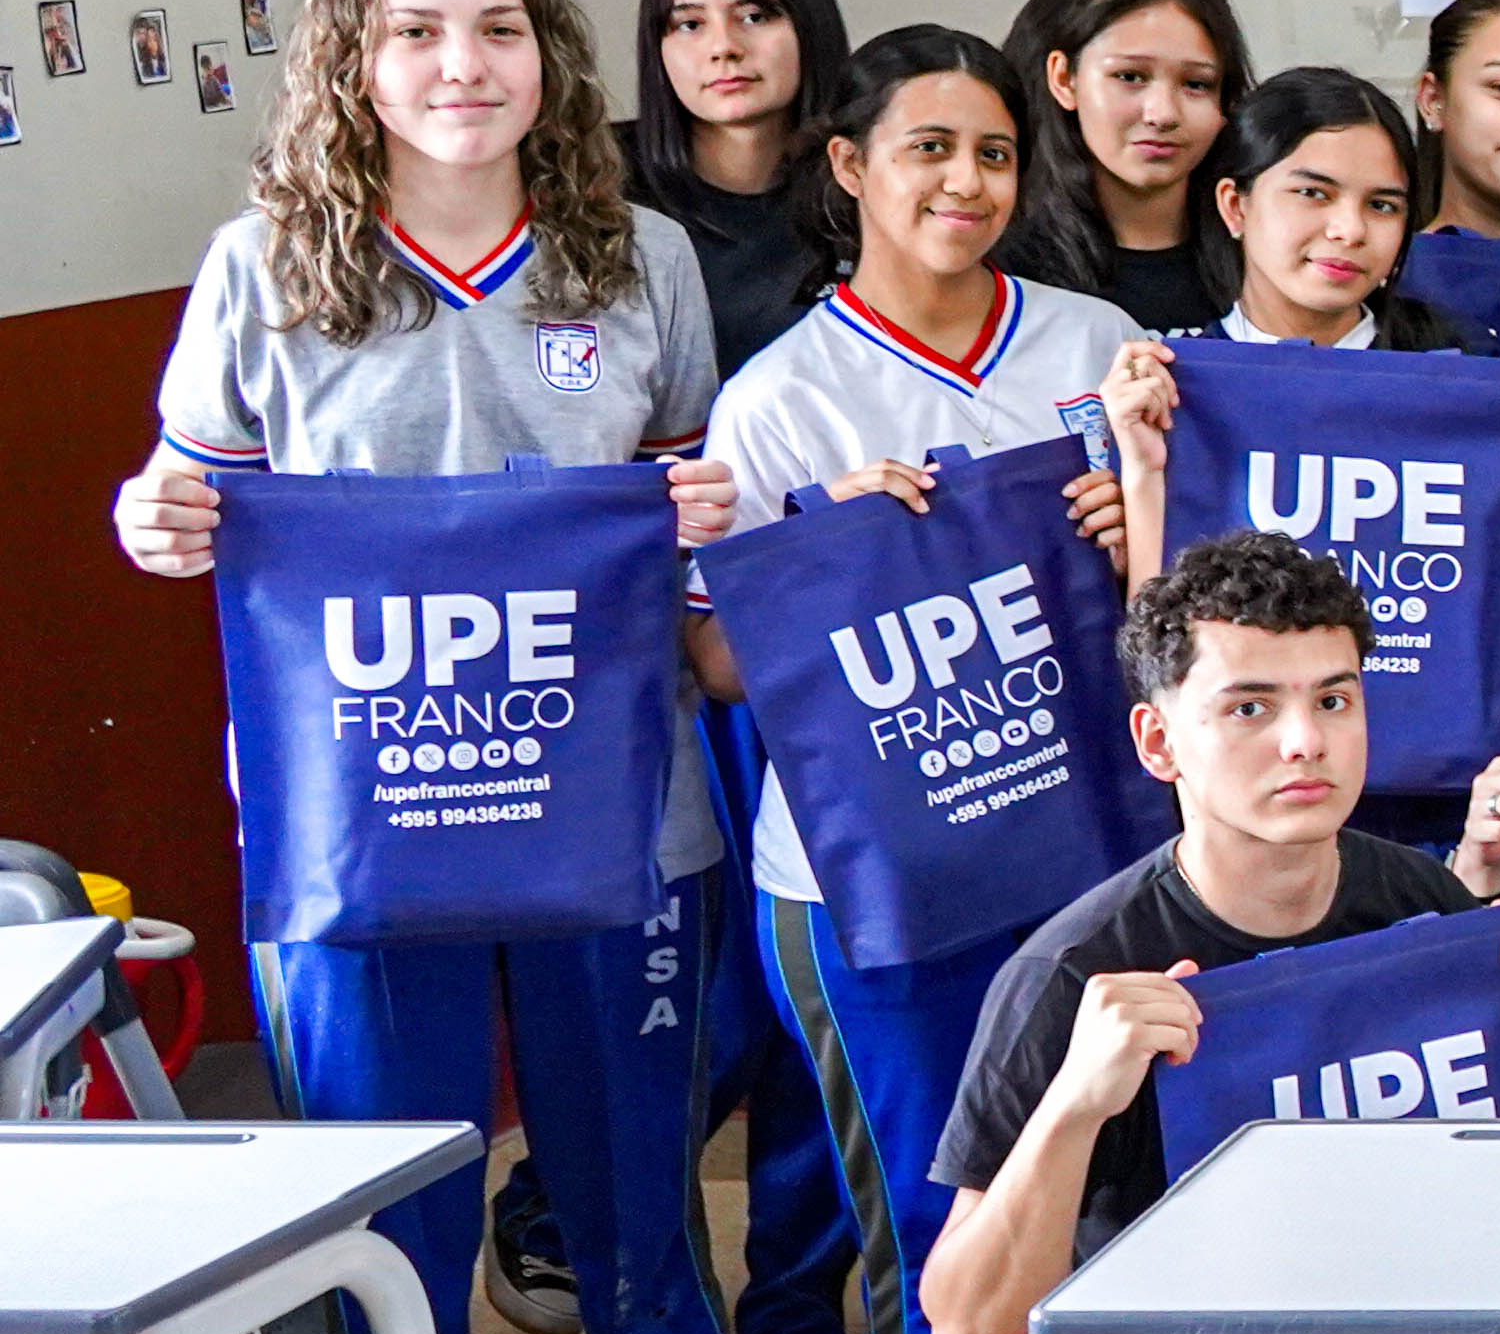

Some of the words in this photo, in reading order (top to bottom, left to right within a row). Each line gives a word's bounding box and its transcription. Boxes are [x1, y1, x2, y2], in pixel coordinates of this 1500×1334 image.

[1247, 451, 1465, 547] UPE
[324, 589, 577, 690] UPE
[829, 564, 1055, 710] UPE
[1362, 656, 1421, 674] 364238
[332, 687, 575, 740] FRANCO
[869, 655, 1063, 760] FRANCO
[374, 774, 551, 803] /upefrancocentral
[926, 737, 1070, 808] /upefrancocentral
[946, 799, 986, 827] +595
[987, 765, 1070, 814] 994364238
[388, 808, 437, 829] +595
[441, 802, 542, 827] 994364238
[640, 895, 680, 1036] NSA
